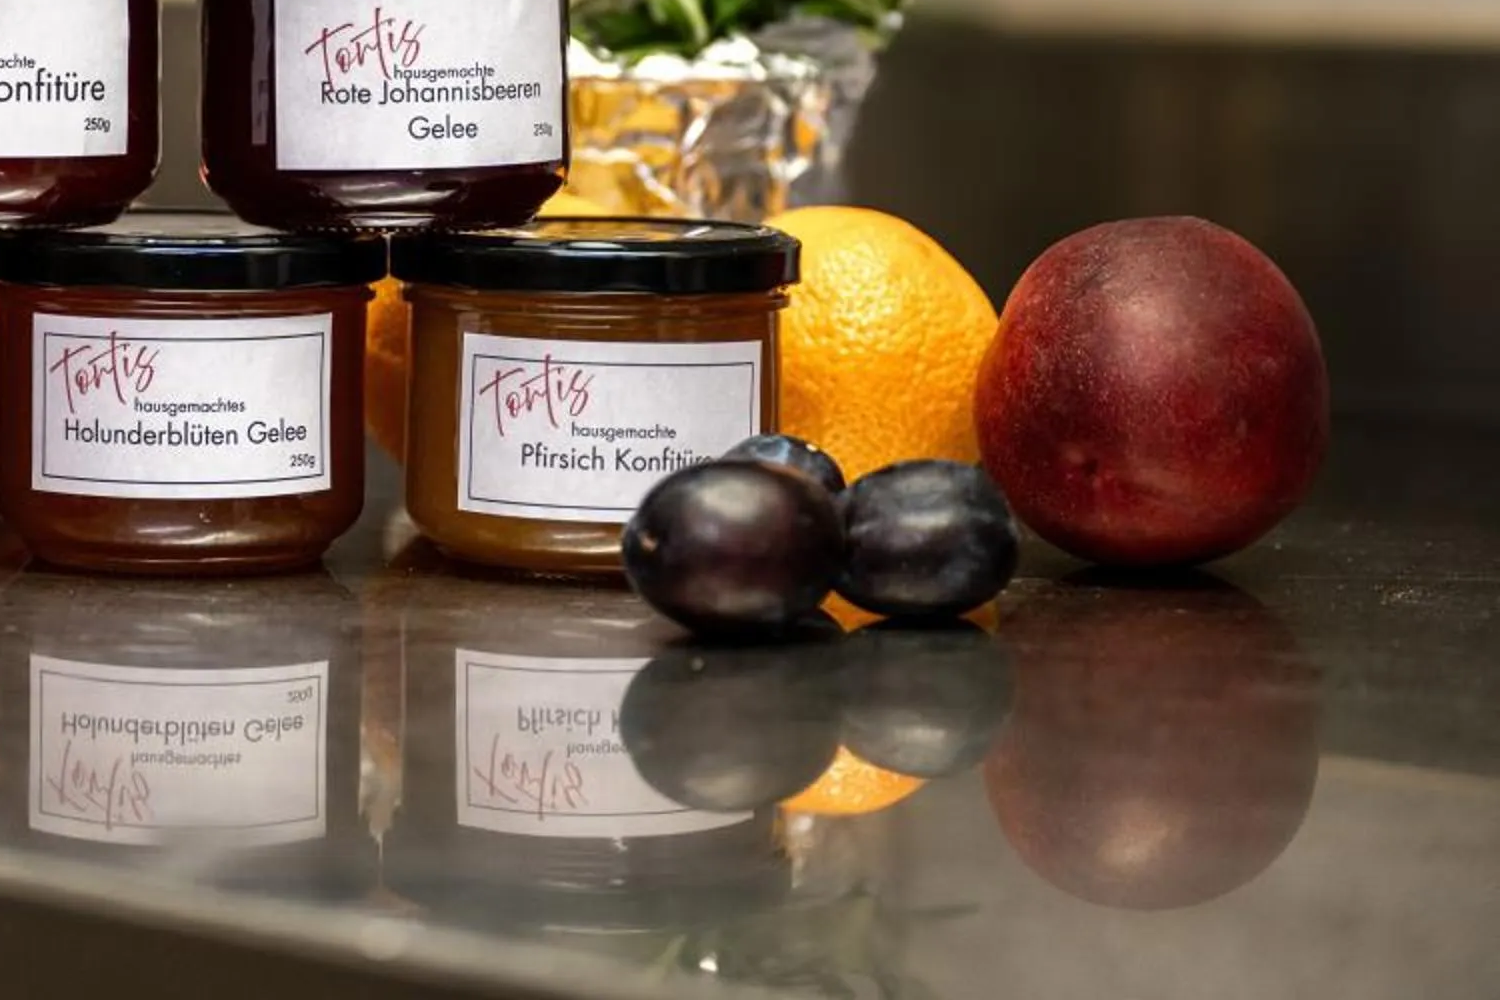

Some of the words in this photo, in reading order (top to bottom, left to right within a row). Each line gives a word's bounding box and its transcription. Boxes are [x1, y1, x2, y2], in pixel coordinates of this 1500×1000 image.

[393, 63, 495, 83] hausgemachte
[321, 81, 372, 106] Rote
[378, 75, 541, 106] Johannisbeeren
[84, 117, 111, 132] 250g
[408, 114, 479, 140] Gelee
[133, 397, 246, 417] hausgemachtes
[64, 418, 239, 447] Holunderblüten
[247, 418, 307, 444] Gelee
[571, 422, 677, 443] hausgemachte
[290, 454, 316, 468] 250g
[521, 443, 604, 471] Pfirsich
